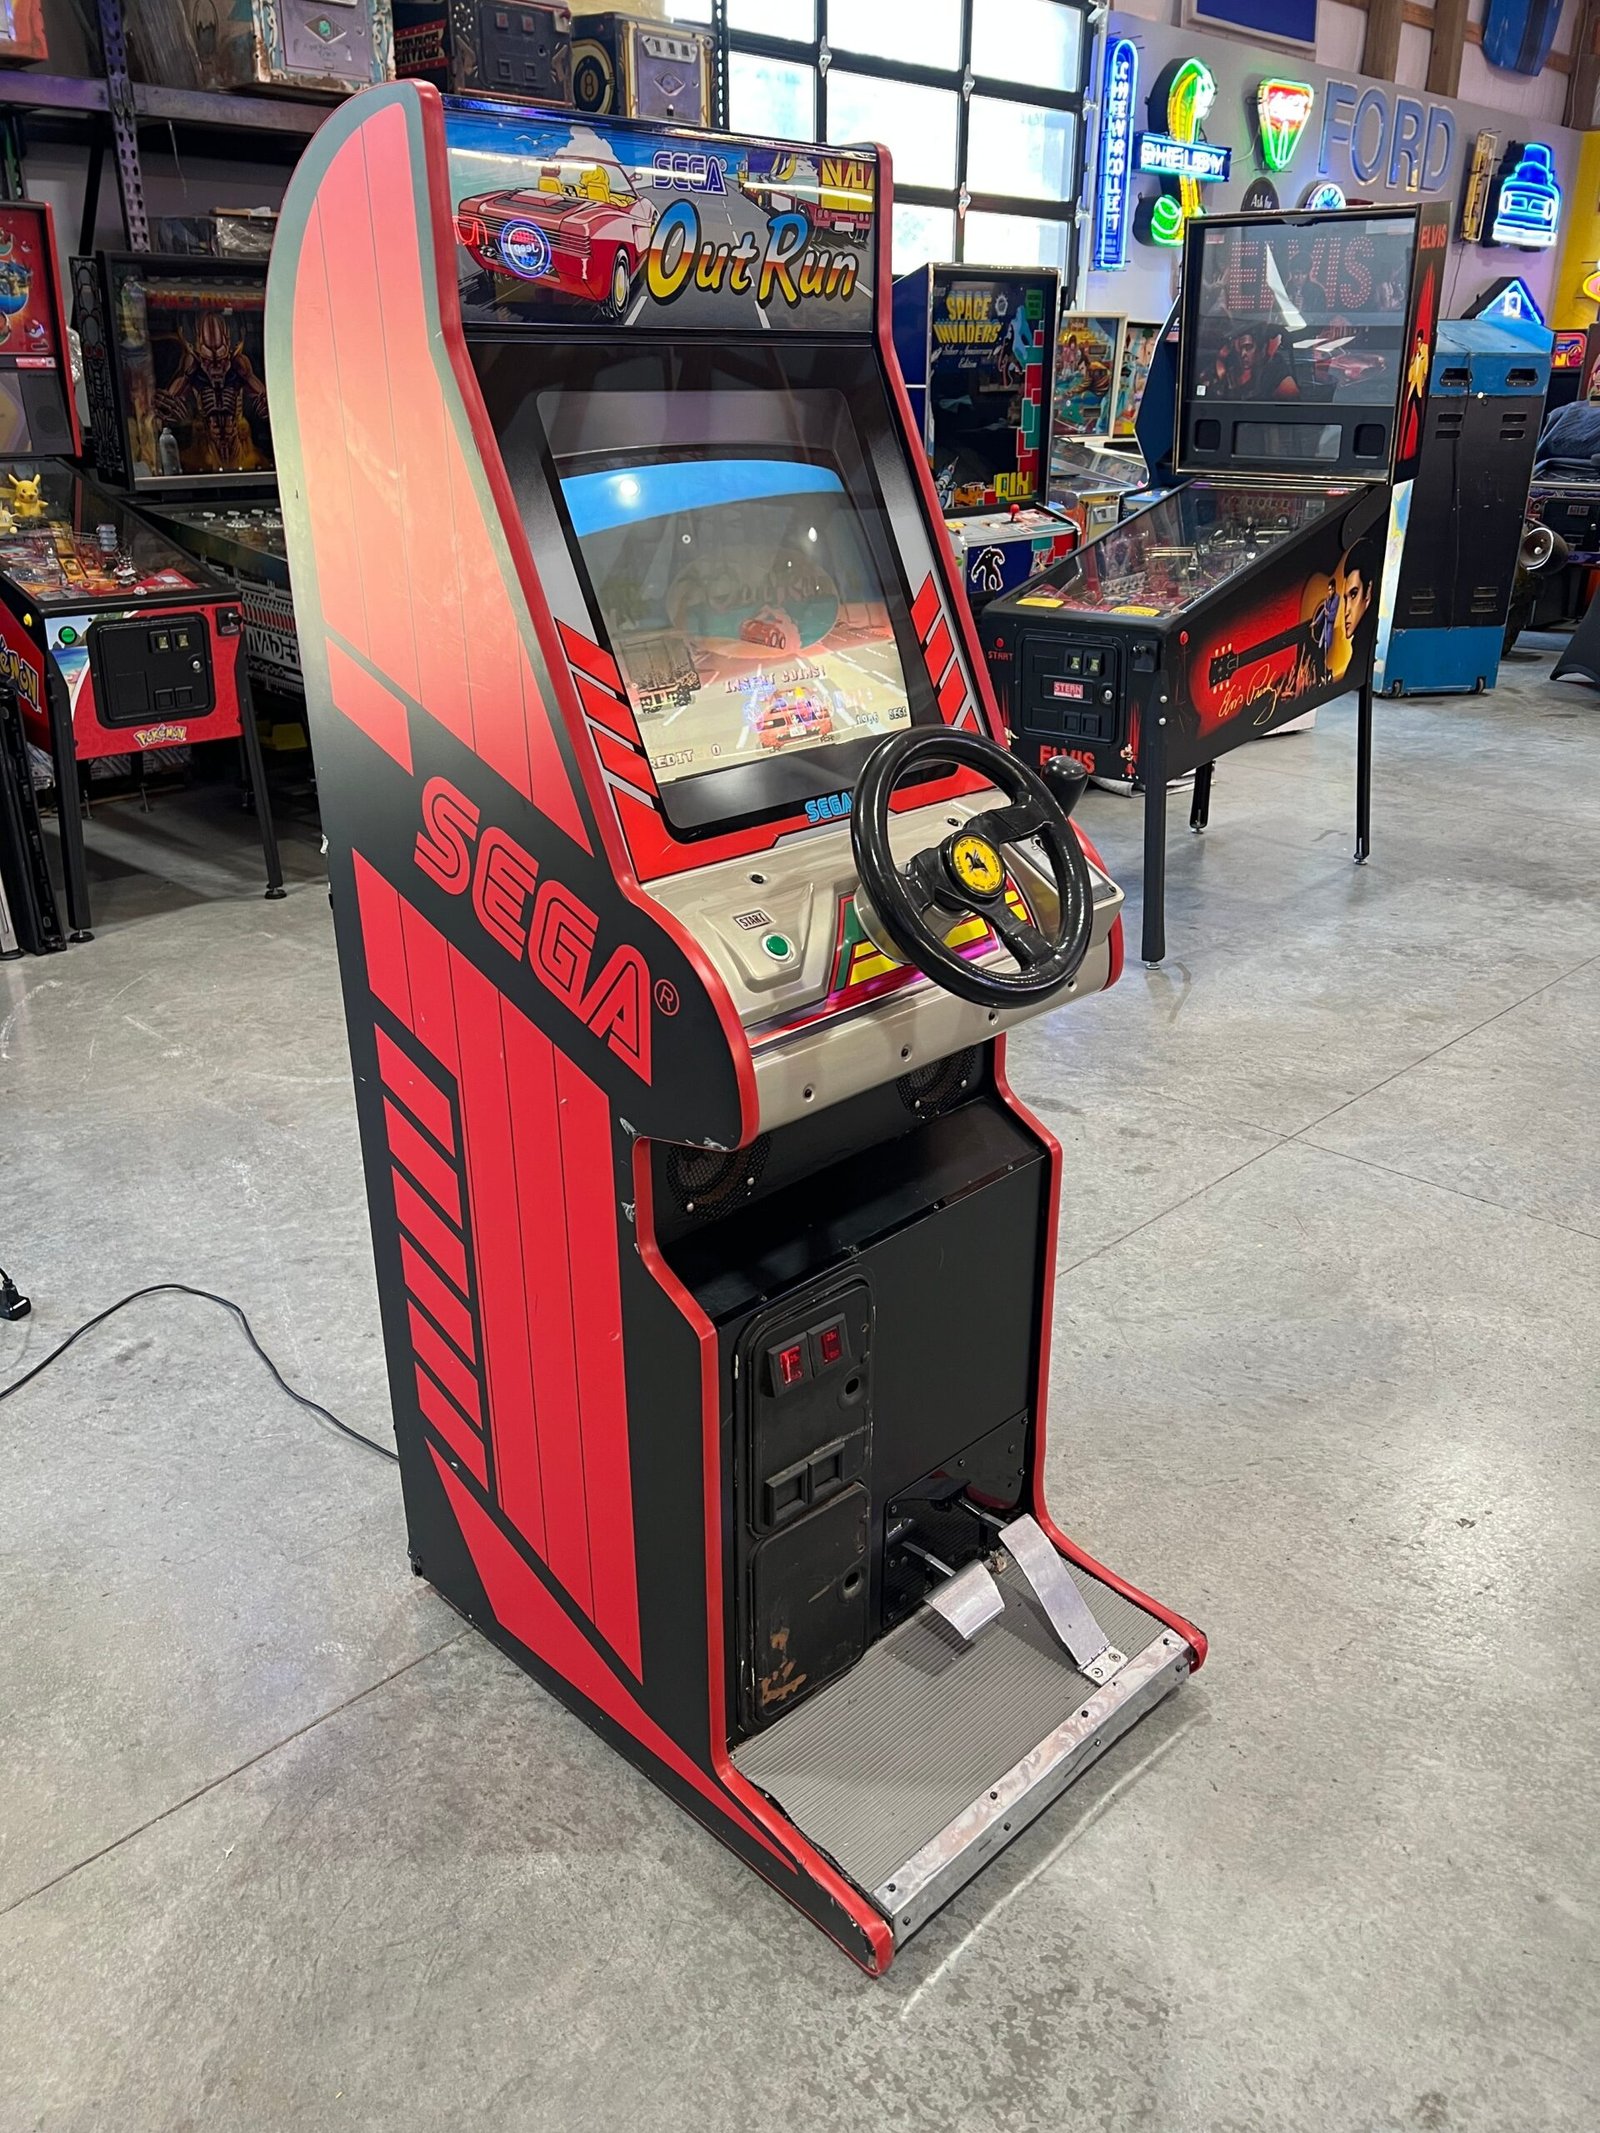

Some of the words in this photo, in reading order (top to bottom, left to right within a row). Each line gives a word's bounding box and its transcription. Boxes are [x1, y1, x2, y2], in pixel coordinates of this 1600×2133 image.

[1316, 78, 1456, 193] FORD
[653, 151, 727, 196] SEGA
[1140, 141, 1226, 177] SHELBY
[1420, 223, 1448, 250] ELVIS
[946, 290, 992, 320] SPACE
[933, 321, 1002, 344] INVADERS
[988, 651, 1014, 661] START
[1054, 682, 1084, 694] STERN
[804, 791, 852, 822] SEGA
[414, 775, 652, 1087] SEGA
[738, 912, 766, 927] START
